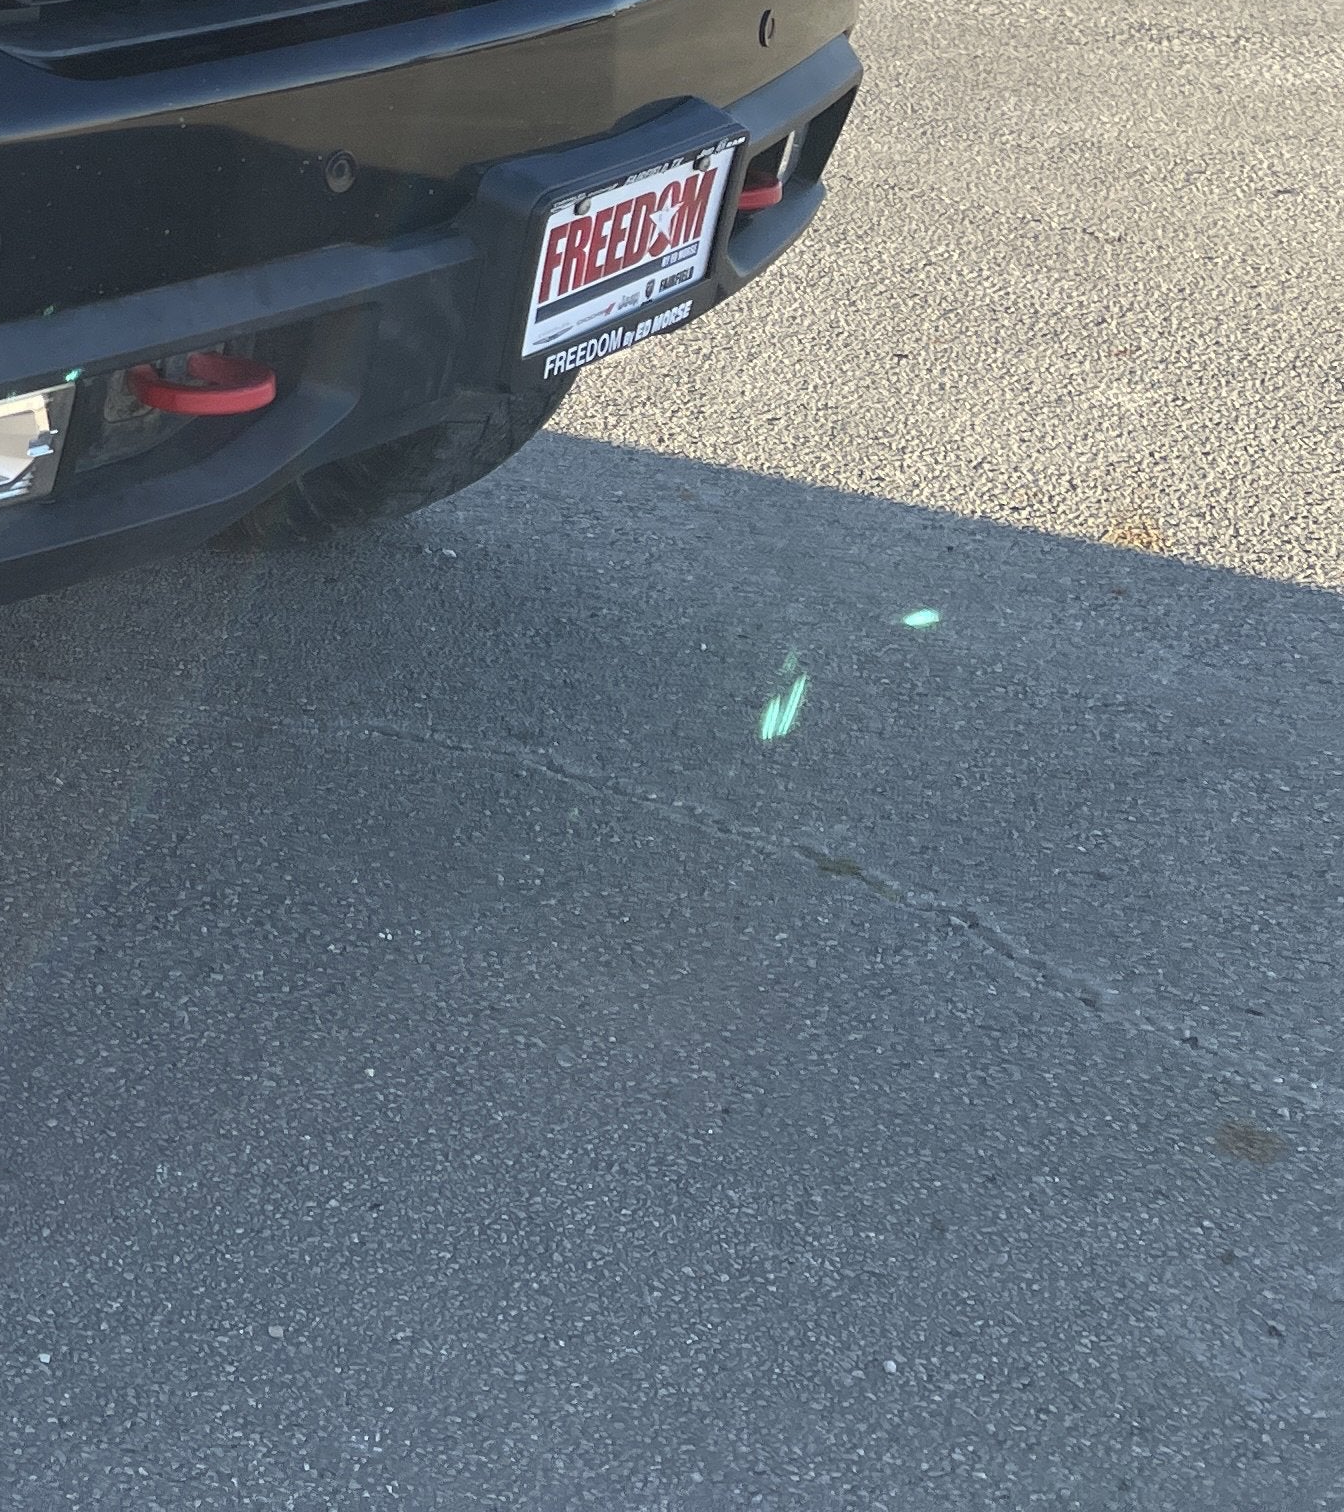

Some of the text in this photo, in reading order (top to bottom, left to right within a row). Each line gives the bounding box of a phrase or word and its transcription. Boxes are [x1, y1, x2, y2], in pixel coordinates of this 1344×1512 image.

[538, 168, 717, 304] FREEDOM
[543, 326, 624, 380] FREEDOM
[634, 319, 653, 341] ED
[650, 300, 694, 333] MORSE
